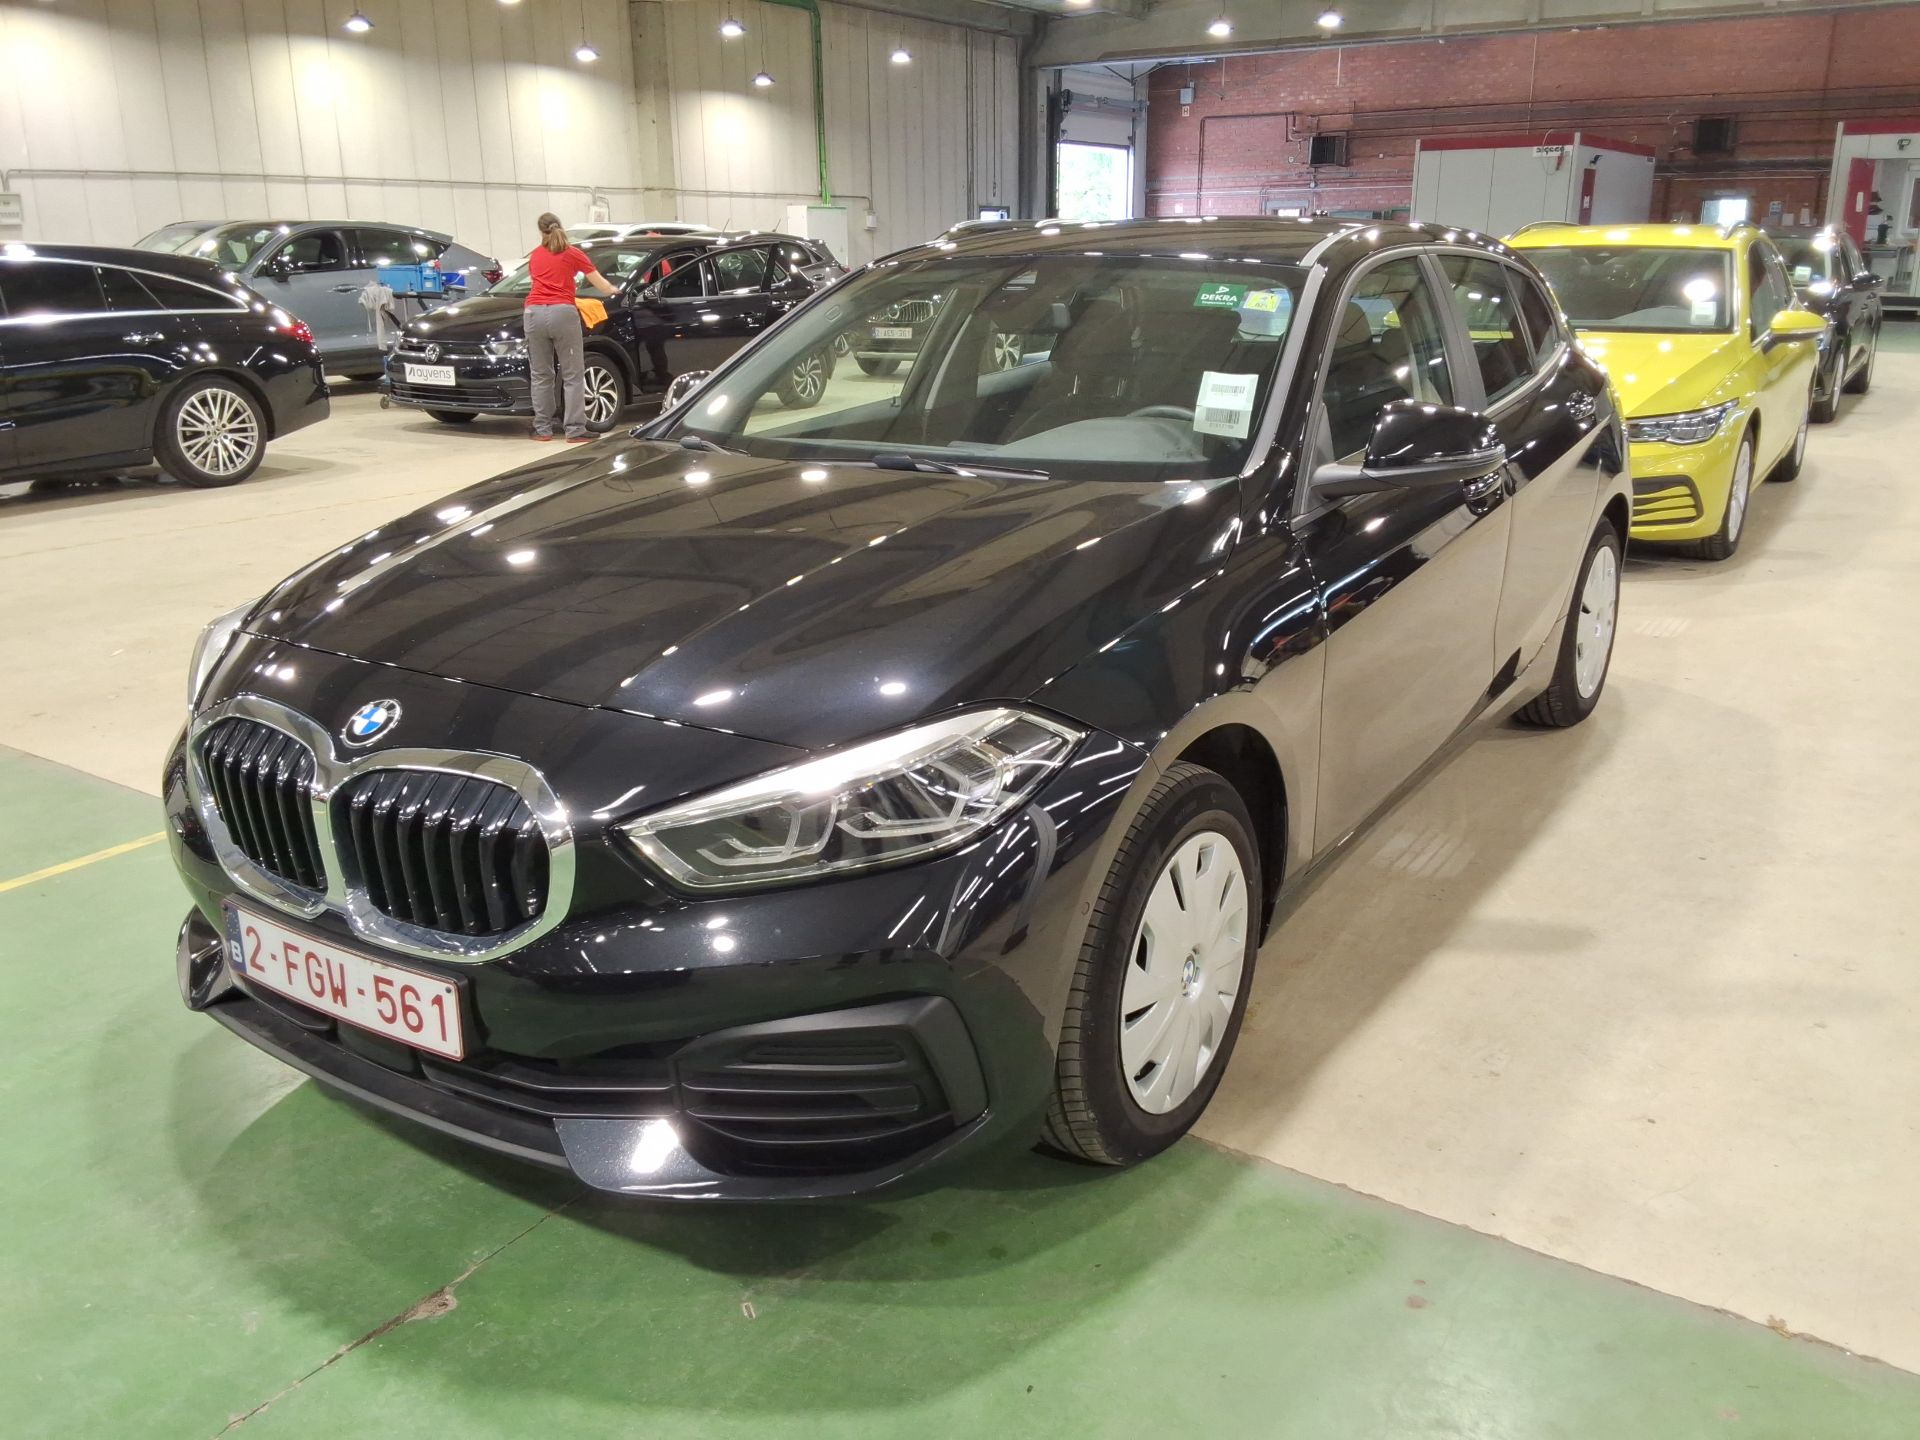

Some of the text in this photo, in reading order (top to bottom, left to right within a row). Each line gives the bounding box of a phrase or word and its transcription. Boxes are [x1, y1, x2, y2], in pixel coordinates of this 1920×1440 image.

[1200, 293, 1237, 302] DEKRA
[416, 367, 452, 382] ayvens
[231, 925, 448, 1042] B 2-FGW-561
